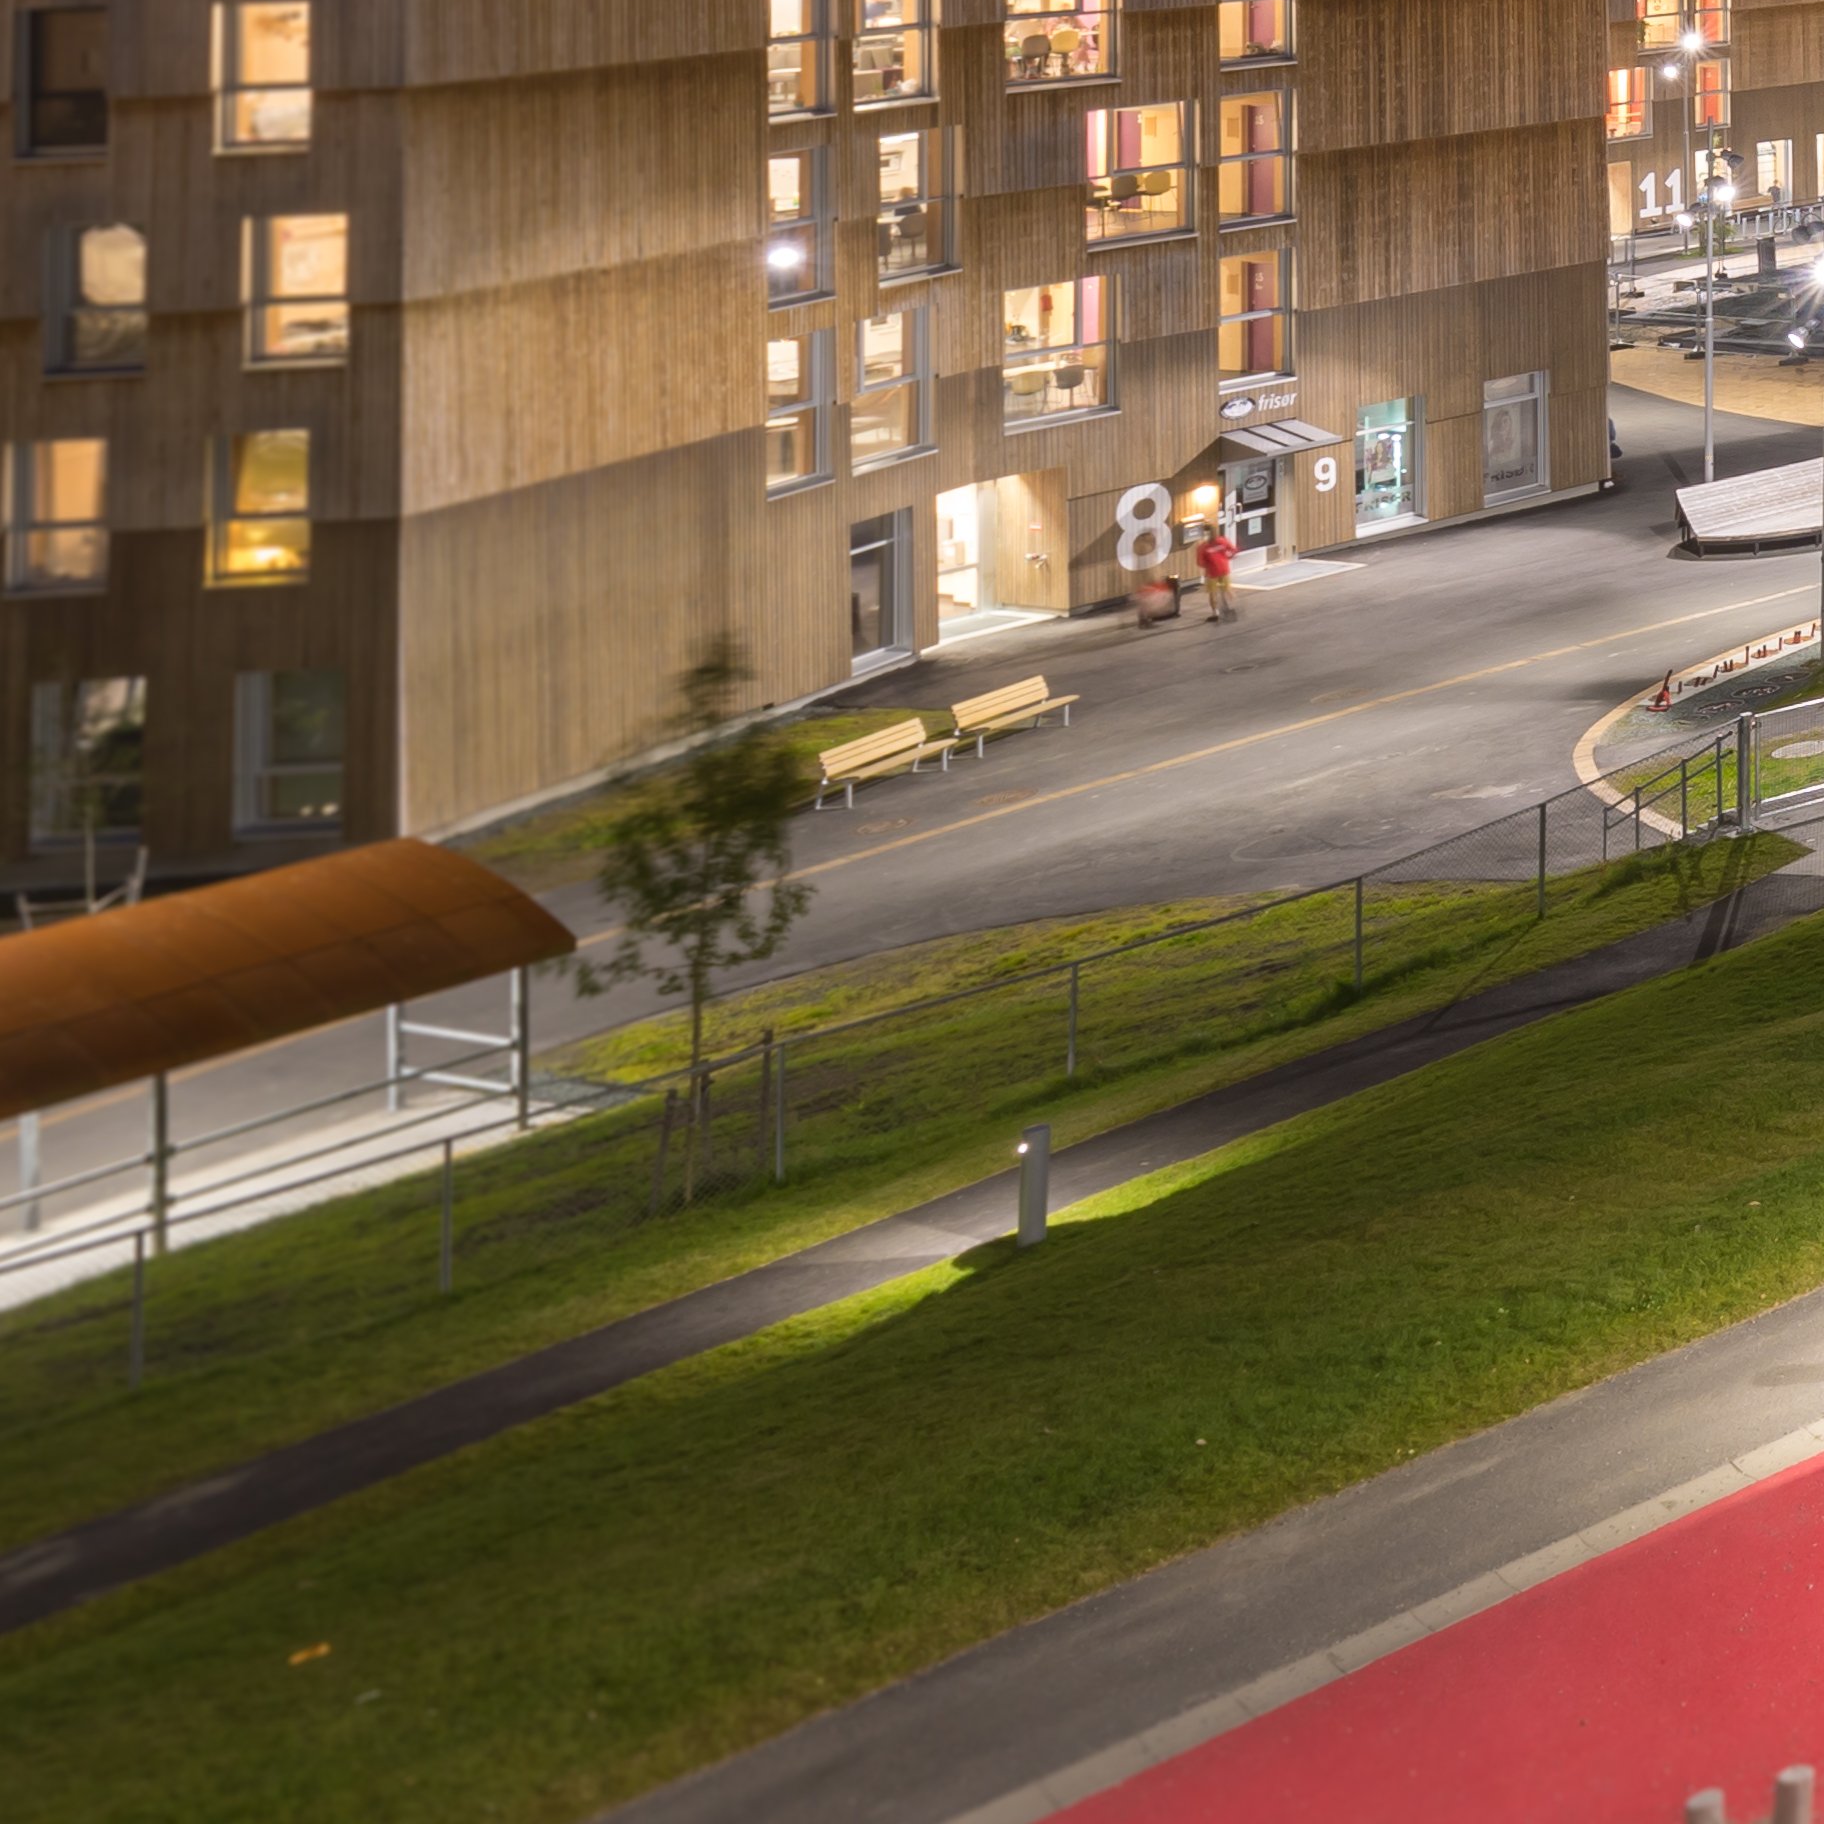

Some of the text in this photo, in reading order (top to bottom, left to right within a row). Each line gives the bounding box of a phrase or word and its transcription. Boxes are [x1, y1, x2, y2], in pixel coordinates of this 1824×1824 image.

[1638, 168, 1685, 219] 11
[1258, 393, 1297, 412] frisør
[1313, 456, 1337, 492] 9
[1115, 482, 1172, 572] 8
